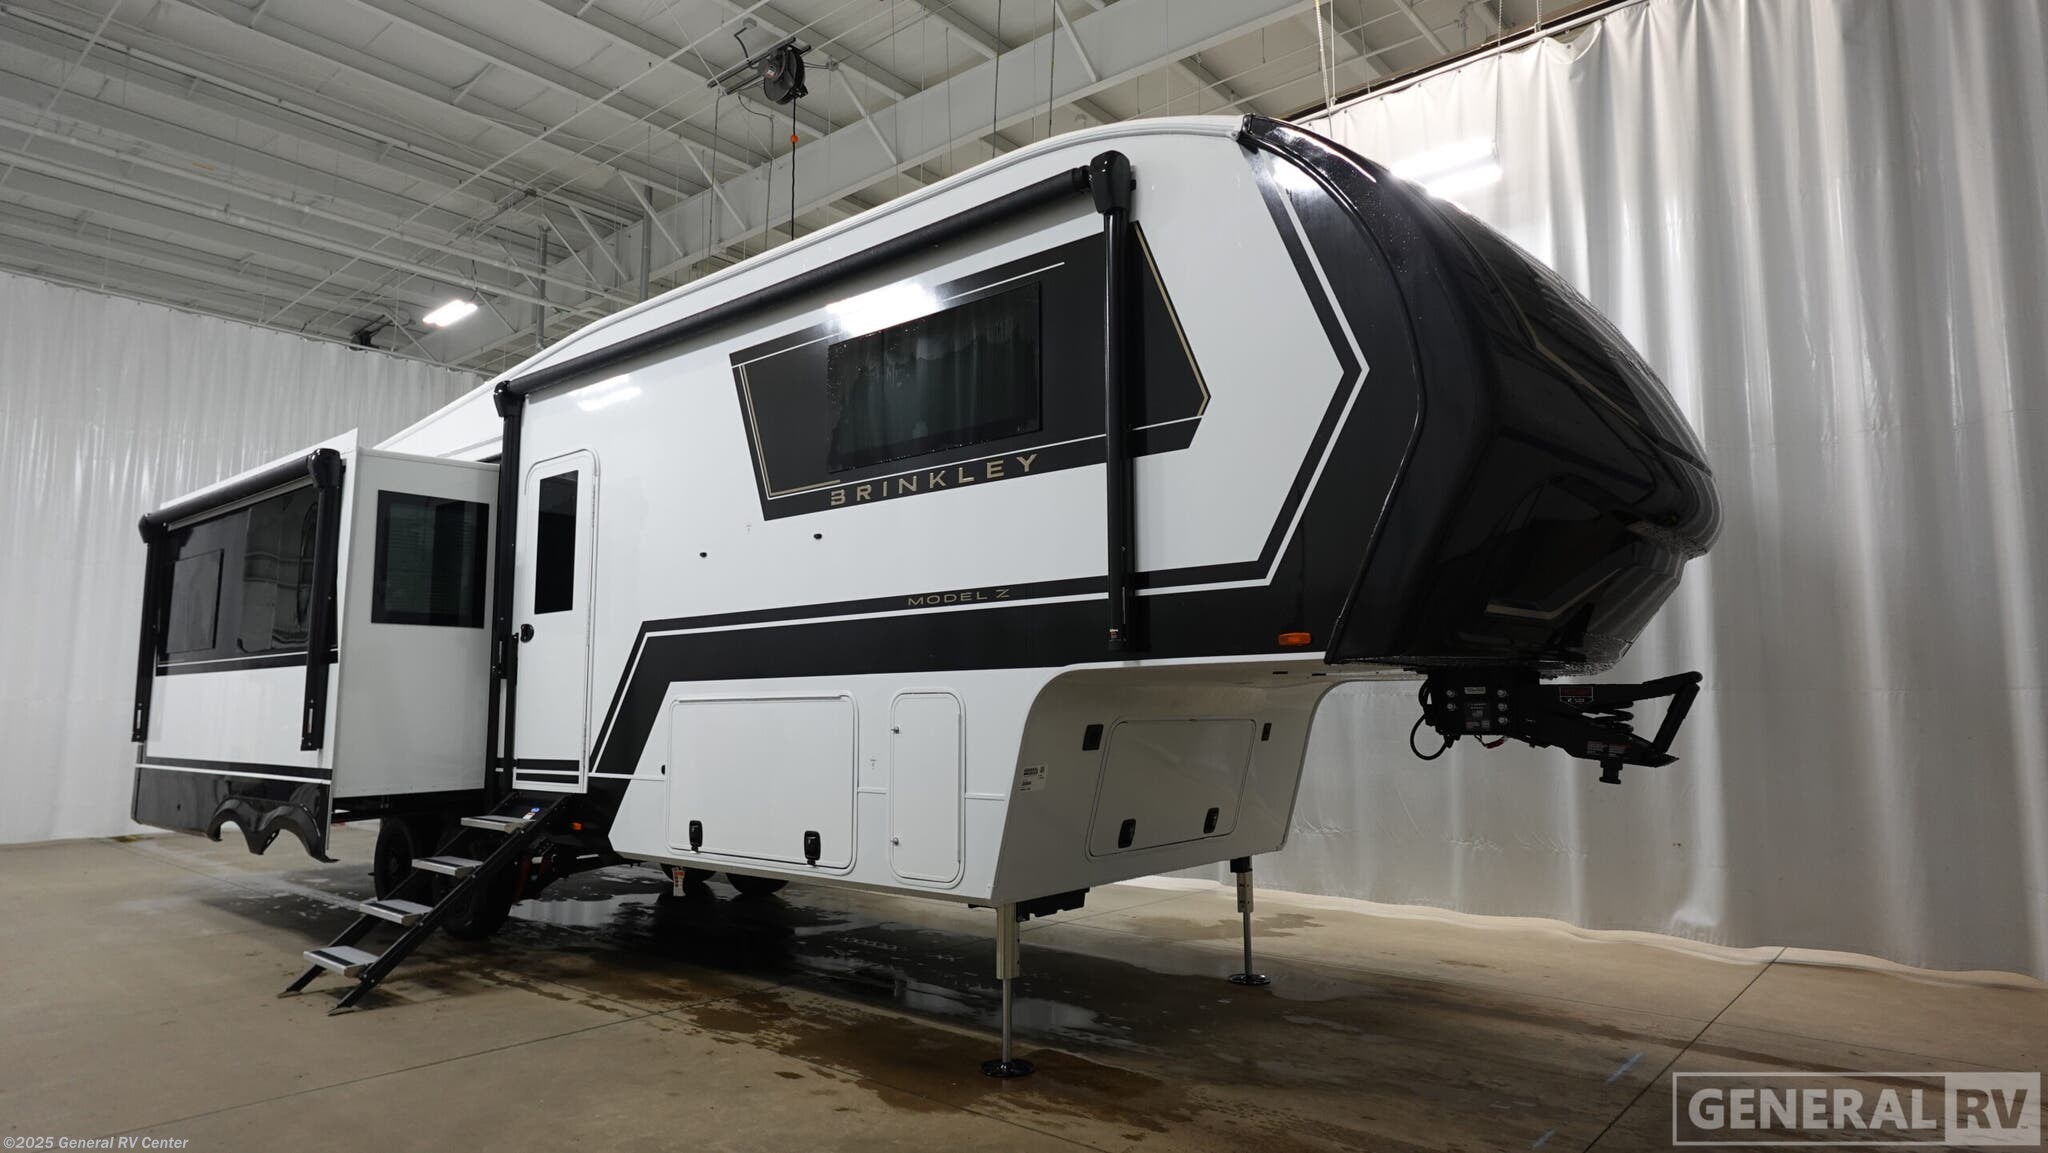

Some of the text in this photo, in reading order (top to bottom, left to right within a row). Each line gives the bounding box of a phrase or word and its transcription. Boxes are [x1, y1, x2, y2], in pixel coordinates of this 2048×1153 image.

[831, 453, 1038, 505] BRINKLEY
[908, 589, 1010, 606] MODEL Z
